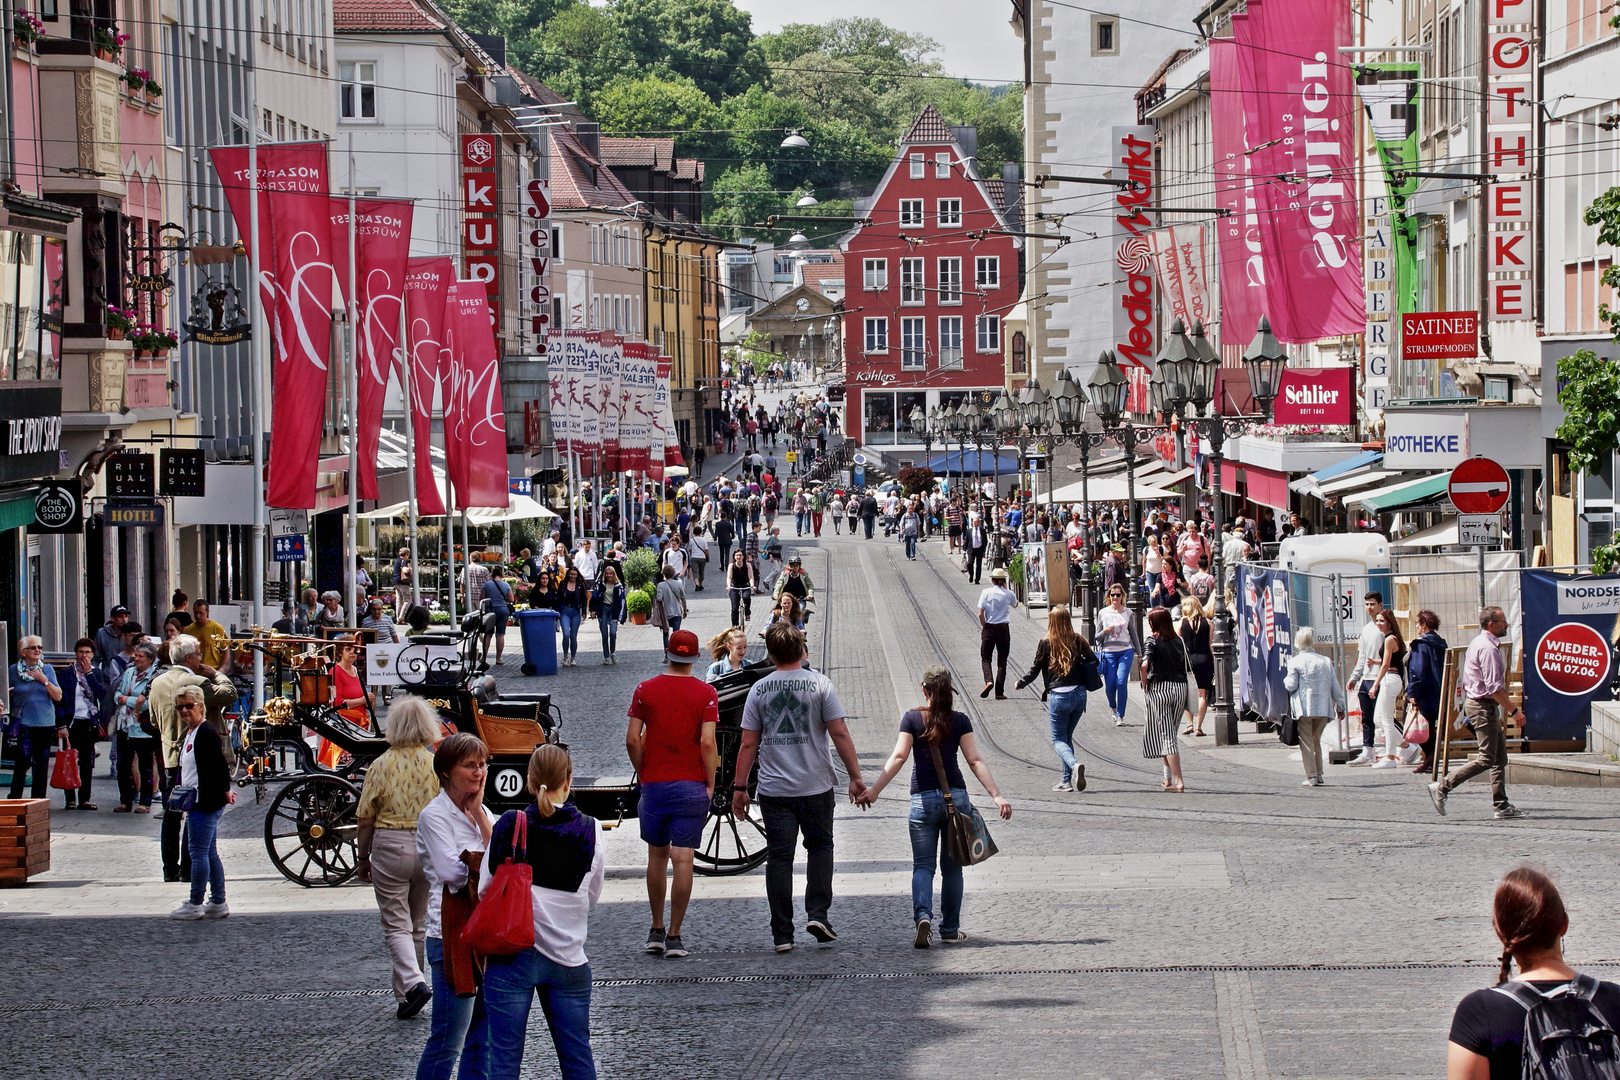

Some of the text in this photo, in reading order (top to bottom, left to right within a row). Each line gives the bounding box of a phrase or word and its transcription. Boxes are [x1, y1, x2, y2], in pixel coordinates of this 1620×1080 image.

[1117, 134, 1152, 378] Media Markt
[130, 274, 169, 291] Hotel
[1370, 197, 1387, 408] FABERGE
[1405, 316, 1475, 337] SATINEE
[1406, 343, 1476, 355] STRUMPFMODEN
[855, 369, 897, 382] Köhlers
[1285, 384, 1339, 406] Schlier
[8, 415, 62, 456] THE BODY SHOP
[1387, 434, 1460, 453] APOTHEKE
[41, 505, 68, 514] BODY
[111, 510, 157, 522] HOTEL
[282, 524, 298, 533] frei
[1546, 639, 1603, 657] WIEDER-
[1544, 652, 1600, 667] ERÖFFNUNG
[1542, 660, 1599, 678] AM 07.06.
[756, 680, 817, 697] SUMMERDAYS
[500, 775, 518, 792] 20
